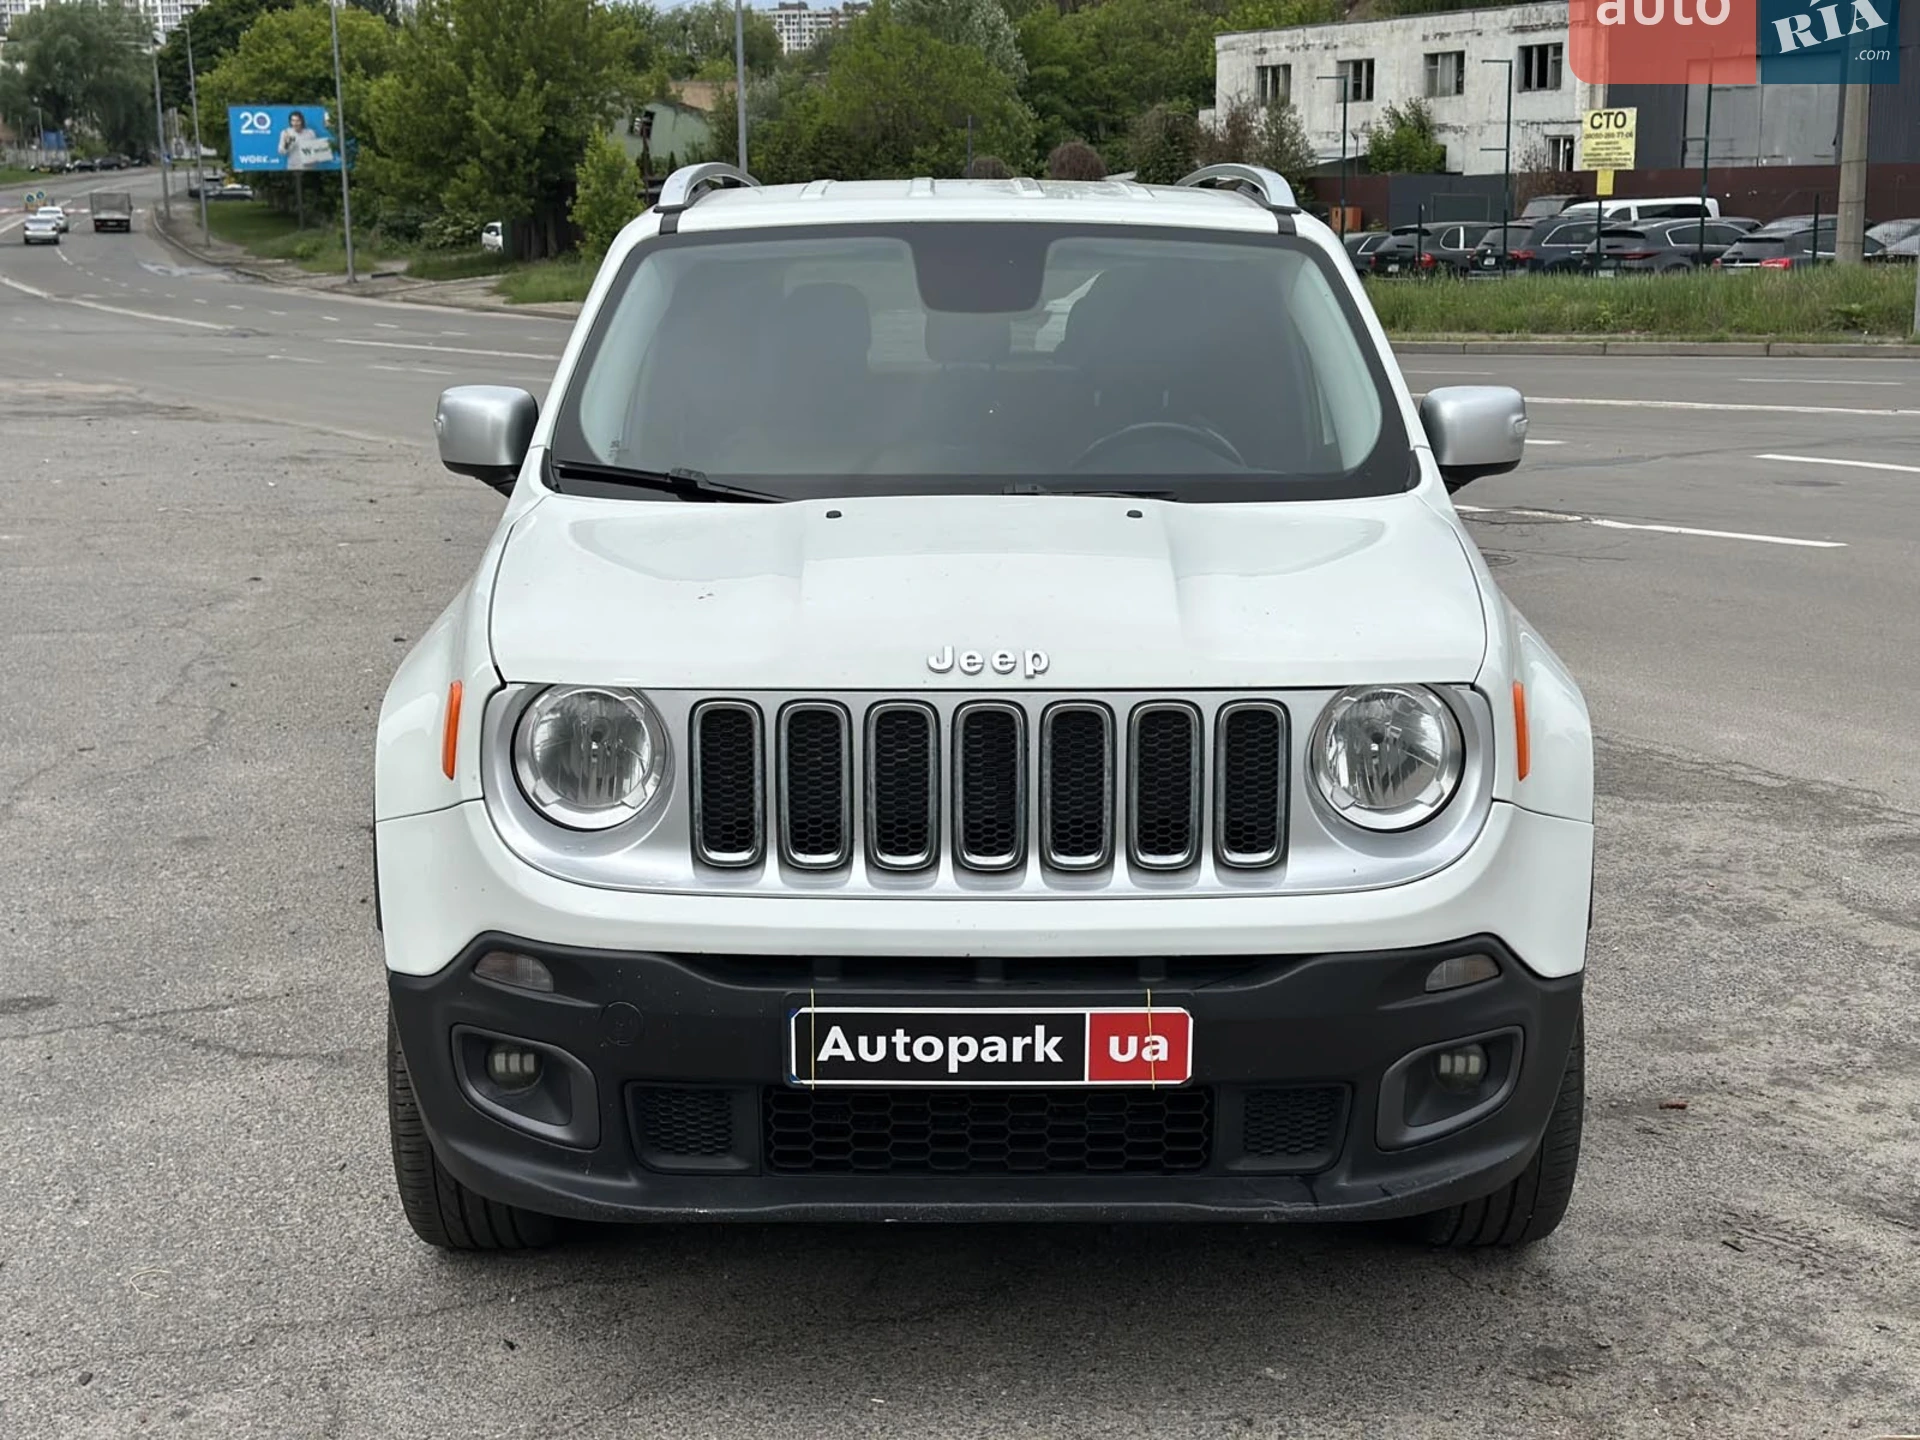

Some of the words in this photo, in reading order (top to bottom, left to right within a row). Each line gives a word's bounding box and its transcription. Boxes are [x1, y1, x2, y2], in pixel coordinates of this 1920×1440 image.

[239, 111, 272, 131] 20
[1590, 111, 1627, 130] СТО
[927, 645, 1050, 679] Jeep
[816, 1024, 1064, 1074] Autopark
[1107, 1034, 1170, 1062] ua
